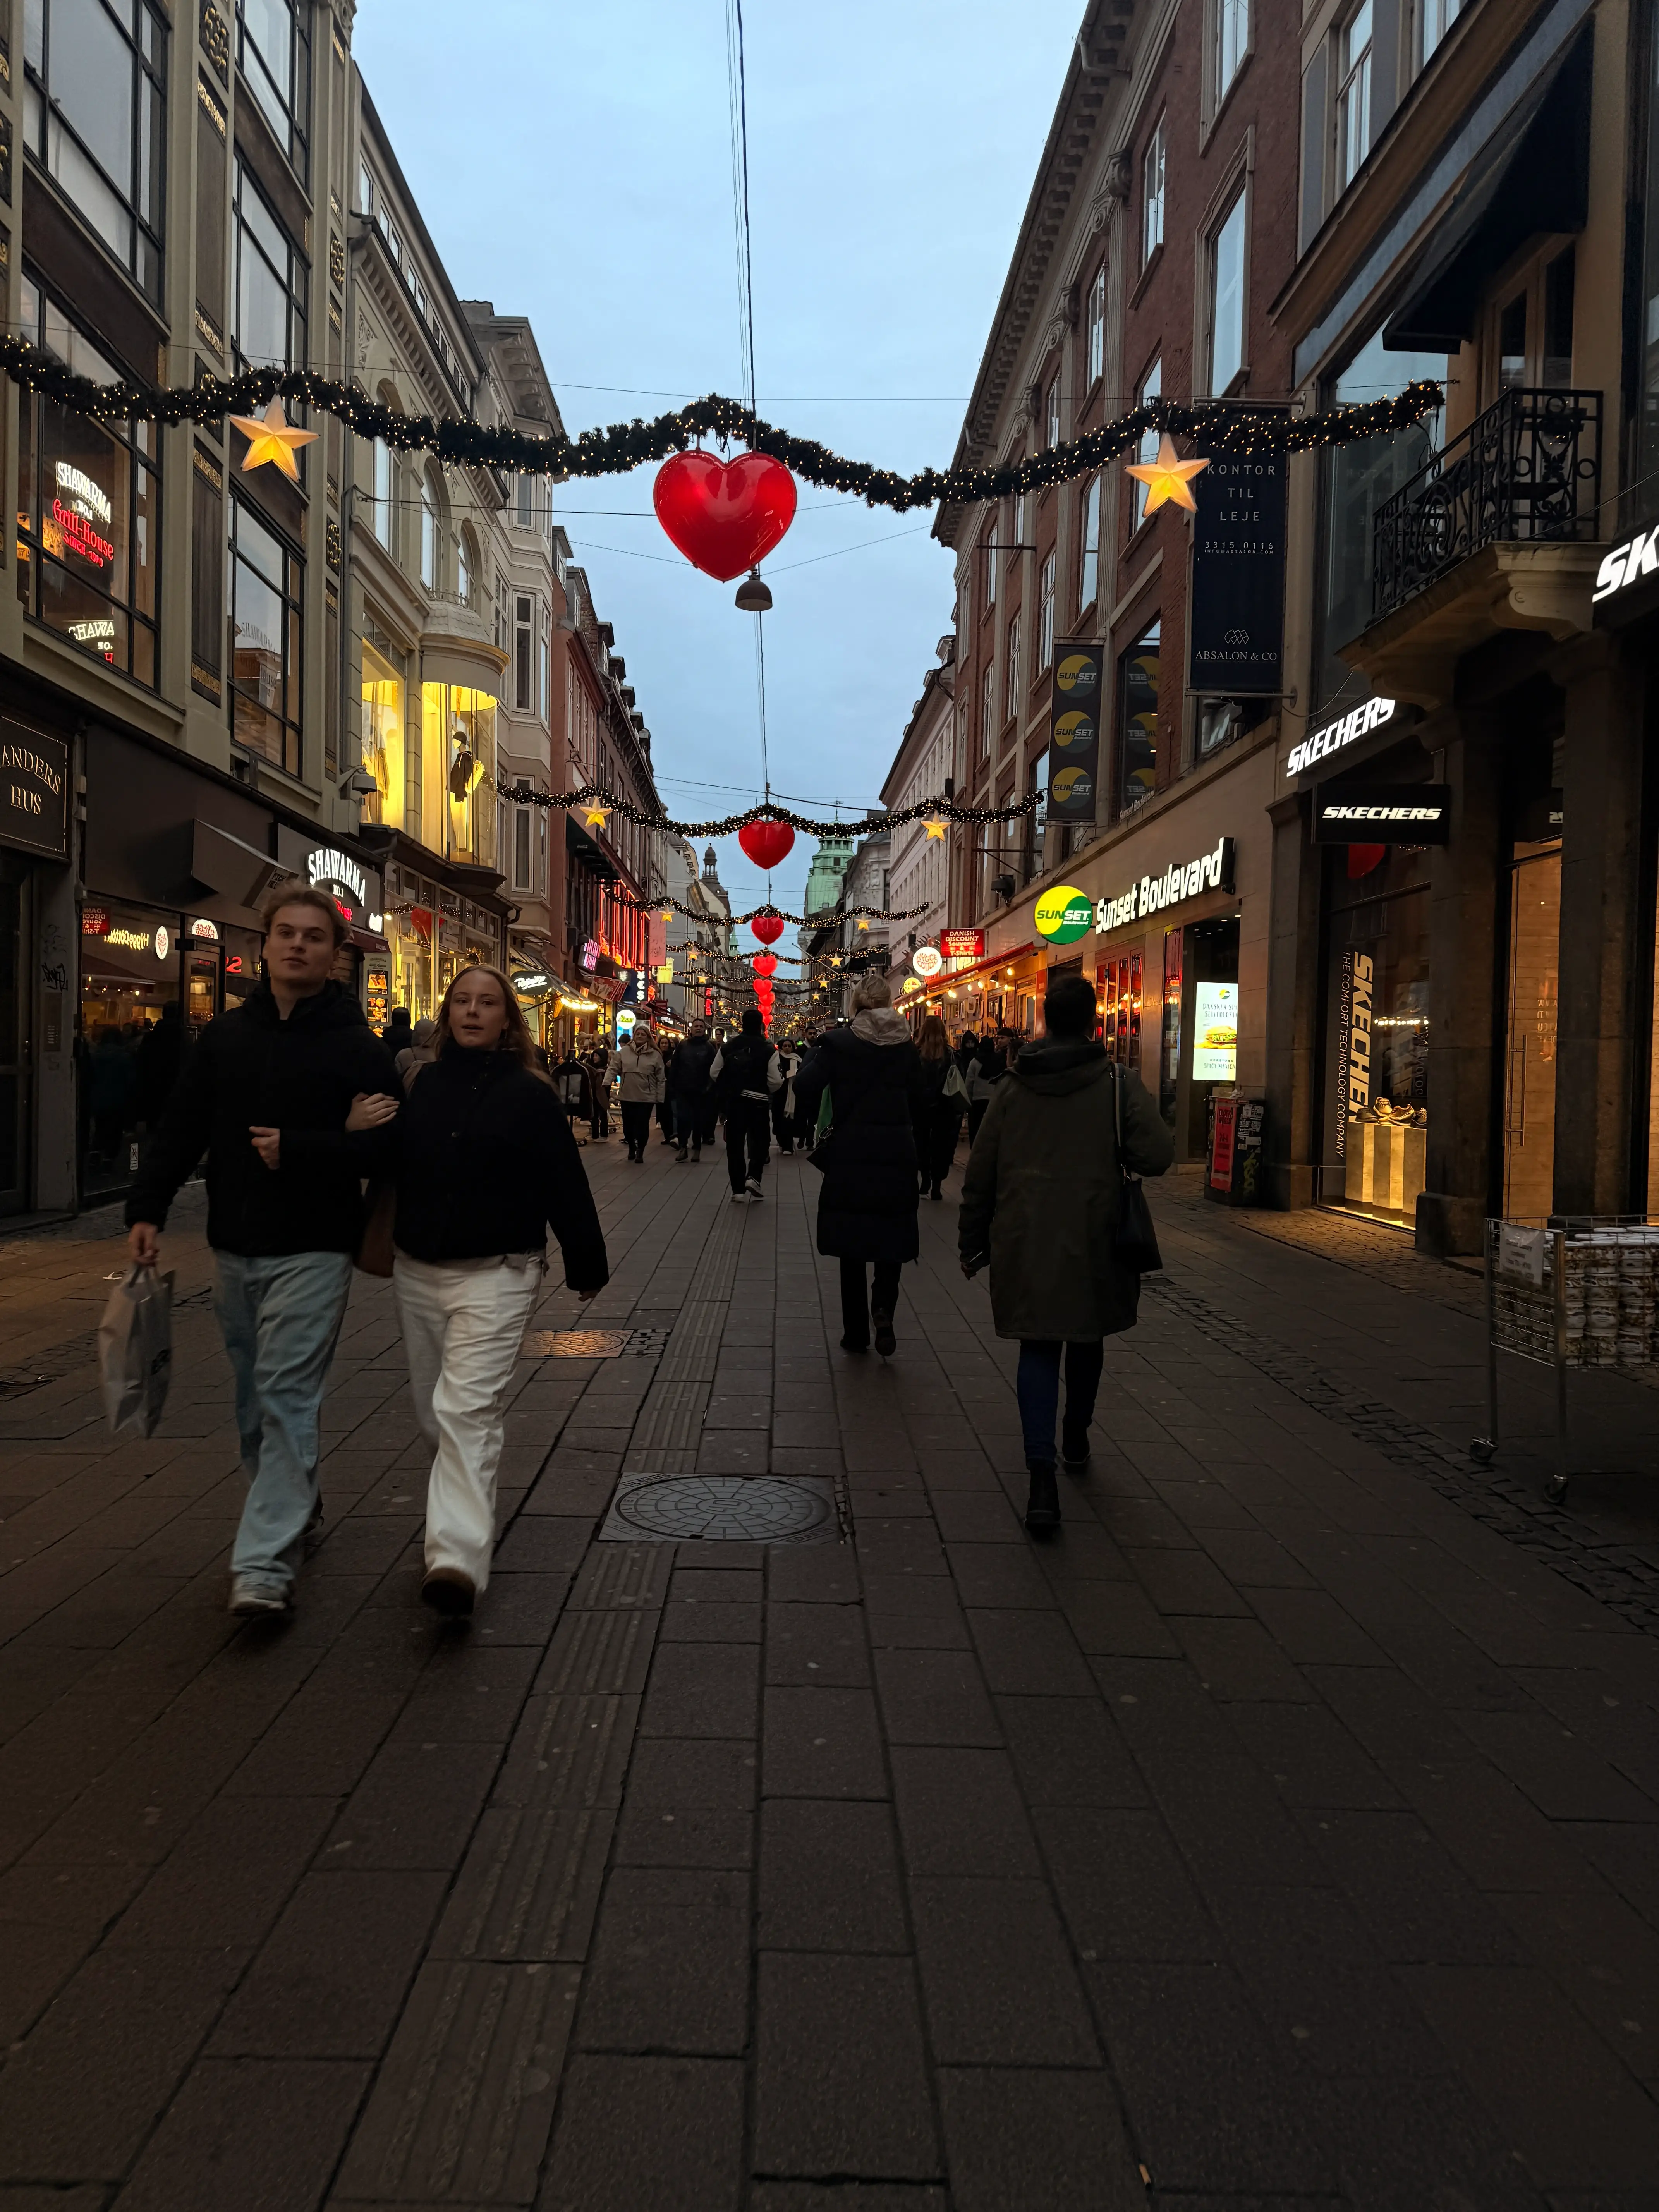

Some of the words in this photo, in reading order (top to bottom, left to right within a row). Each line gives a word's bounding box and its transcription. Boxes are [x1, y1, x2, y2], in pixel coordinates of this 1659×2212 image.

[1207, 464, 1275, 475] KONTOR
[58, 462, 111, 524] SHAWARMA
[1228, 488, 1254, 498] TIL
[1220, 512, 1259, 521] LEJE
[53, 499, 113, 560] Grill-House
[1195, 651, 1247, 660] ABSALON
[1250, 652, 1259, 660] &
[1262, 652, 1277, 661] CO
[1286, 697, 1395, 777] SKECHERS
[11, 784, 41, 815] HUS
[1322, 806, 1442, 820] SKECHERS
[308, 848, 365, 907] SHAWARMA
[1096, 883, 1137, 934] Sunset
[1139, 837, 1224, 917] Boulevard
[333, 884, 343, 897] NO.1
[1036, 910, 1091, 921] SUNSET
[916, 953, 938, 962] HYGGE
[917, 959, 938, 971] COTTON
[1342, 951, 1351, 971] THE
[1340, 974, 1350, 1027] COMFORT
[1337, 1030, 1348, 1102] TECHNOLOGY
[1336, 1104, 1345, 1157] COMPANY
[623, 1474, 671, 1486] ULEFOS
